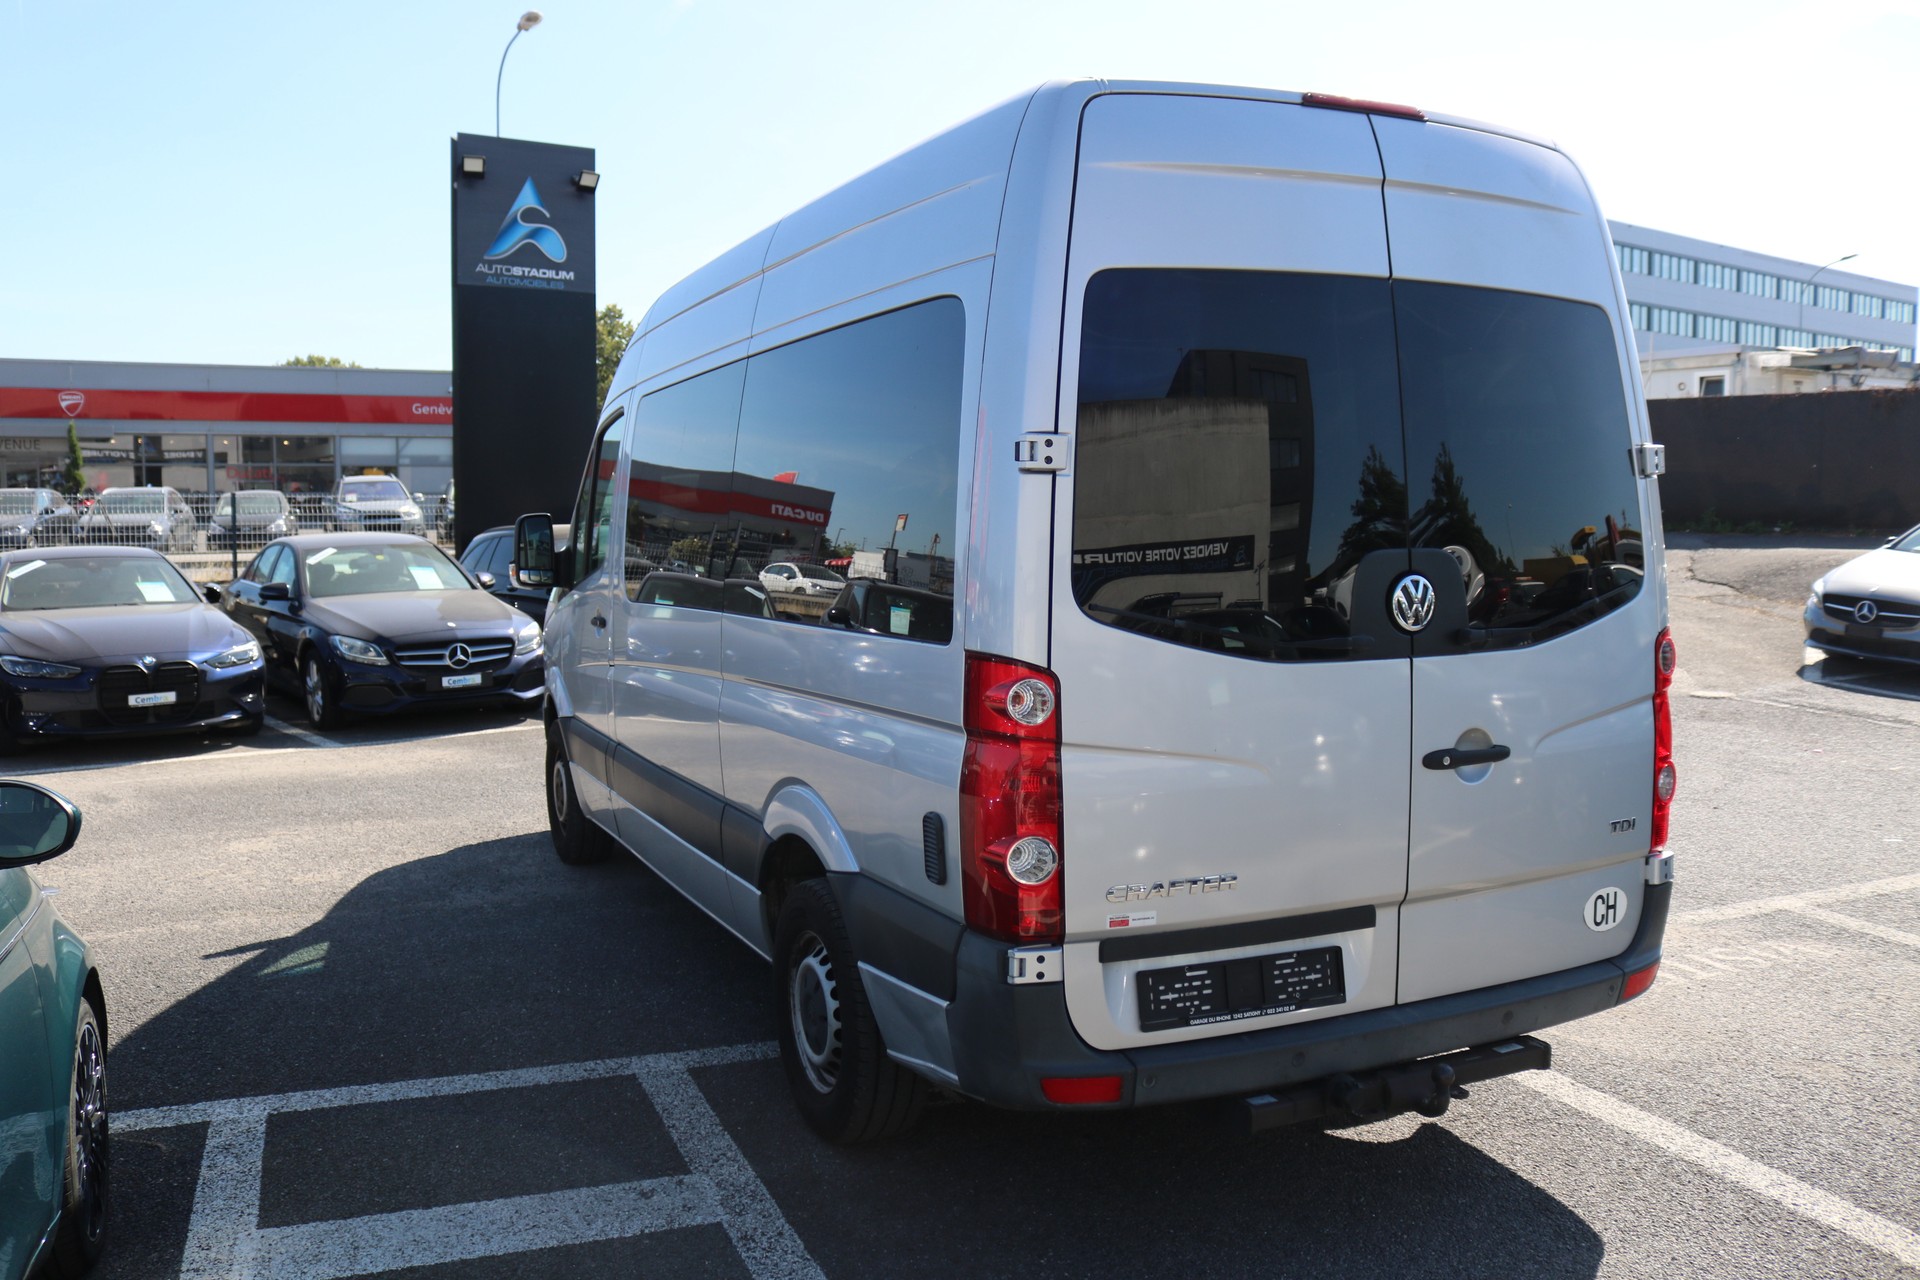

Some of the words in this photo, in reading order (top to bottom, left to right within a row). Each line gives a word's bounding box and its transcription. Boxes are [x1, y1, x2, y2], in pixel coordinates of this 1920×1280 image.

[475, 263, 575, 281] AUTOSTADIUM
[486, 275, 565, 290] AUTOMOBILES
[1610, 817, 1636, 833] TDI
[1106, 872, 1238, 903] CRAFTER
[1593, 891, 1618, 927] CH
